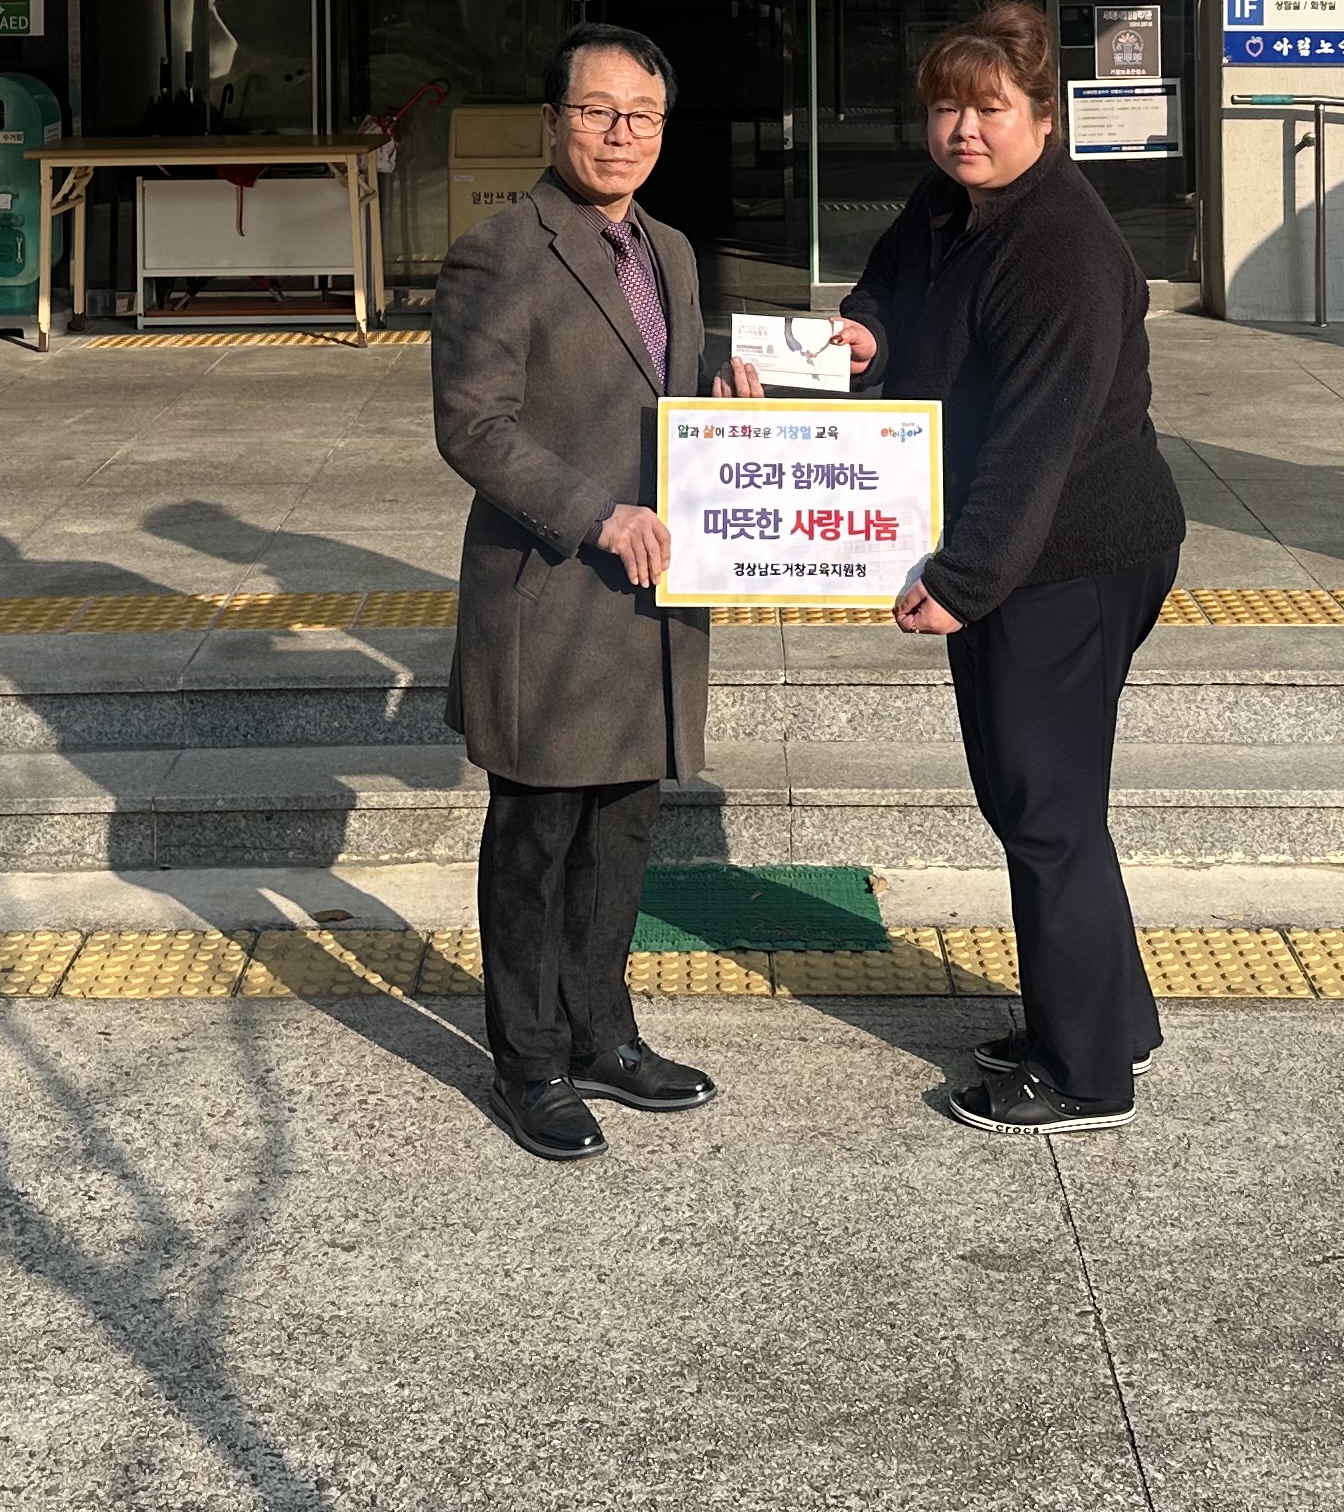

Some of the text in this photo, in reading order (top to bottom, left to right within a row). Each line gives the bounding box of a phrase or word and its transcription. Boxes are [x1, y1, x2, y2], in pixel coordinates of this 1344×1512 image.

[1275, 1, 1300, 10] 상담실
[1311, 1, 1336, 10] 화장실
[0, 16, 28, 30] AED
[728, 424, 772, 439] 조화로운
[815, 426, 839, 440] 교육
[719, 462, 879, 491] 이웃과 함께하는
[703, 508, 900, 542] 따뜻한 사랑 나눔
[733, 562, 867, 578] 경상남도거창교육지원청
[996, 1124, 1039, 1135] crocs
